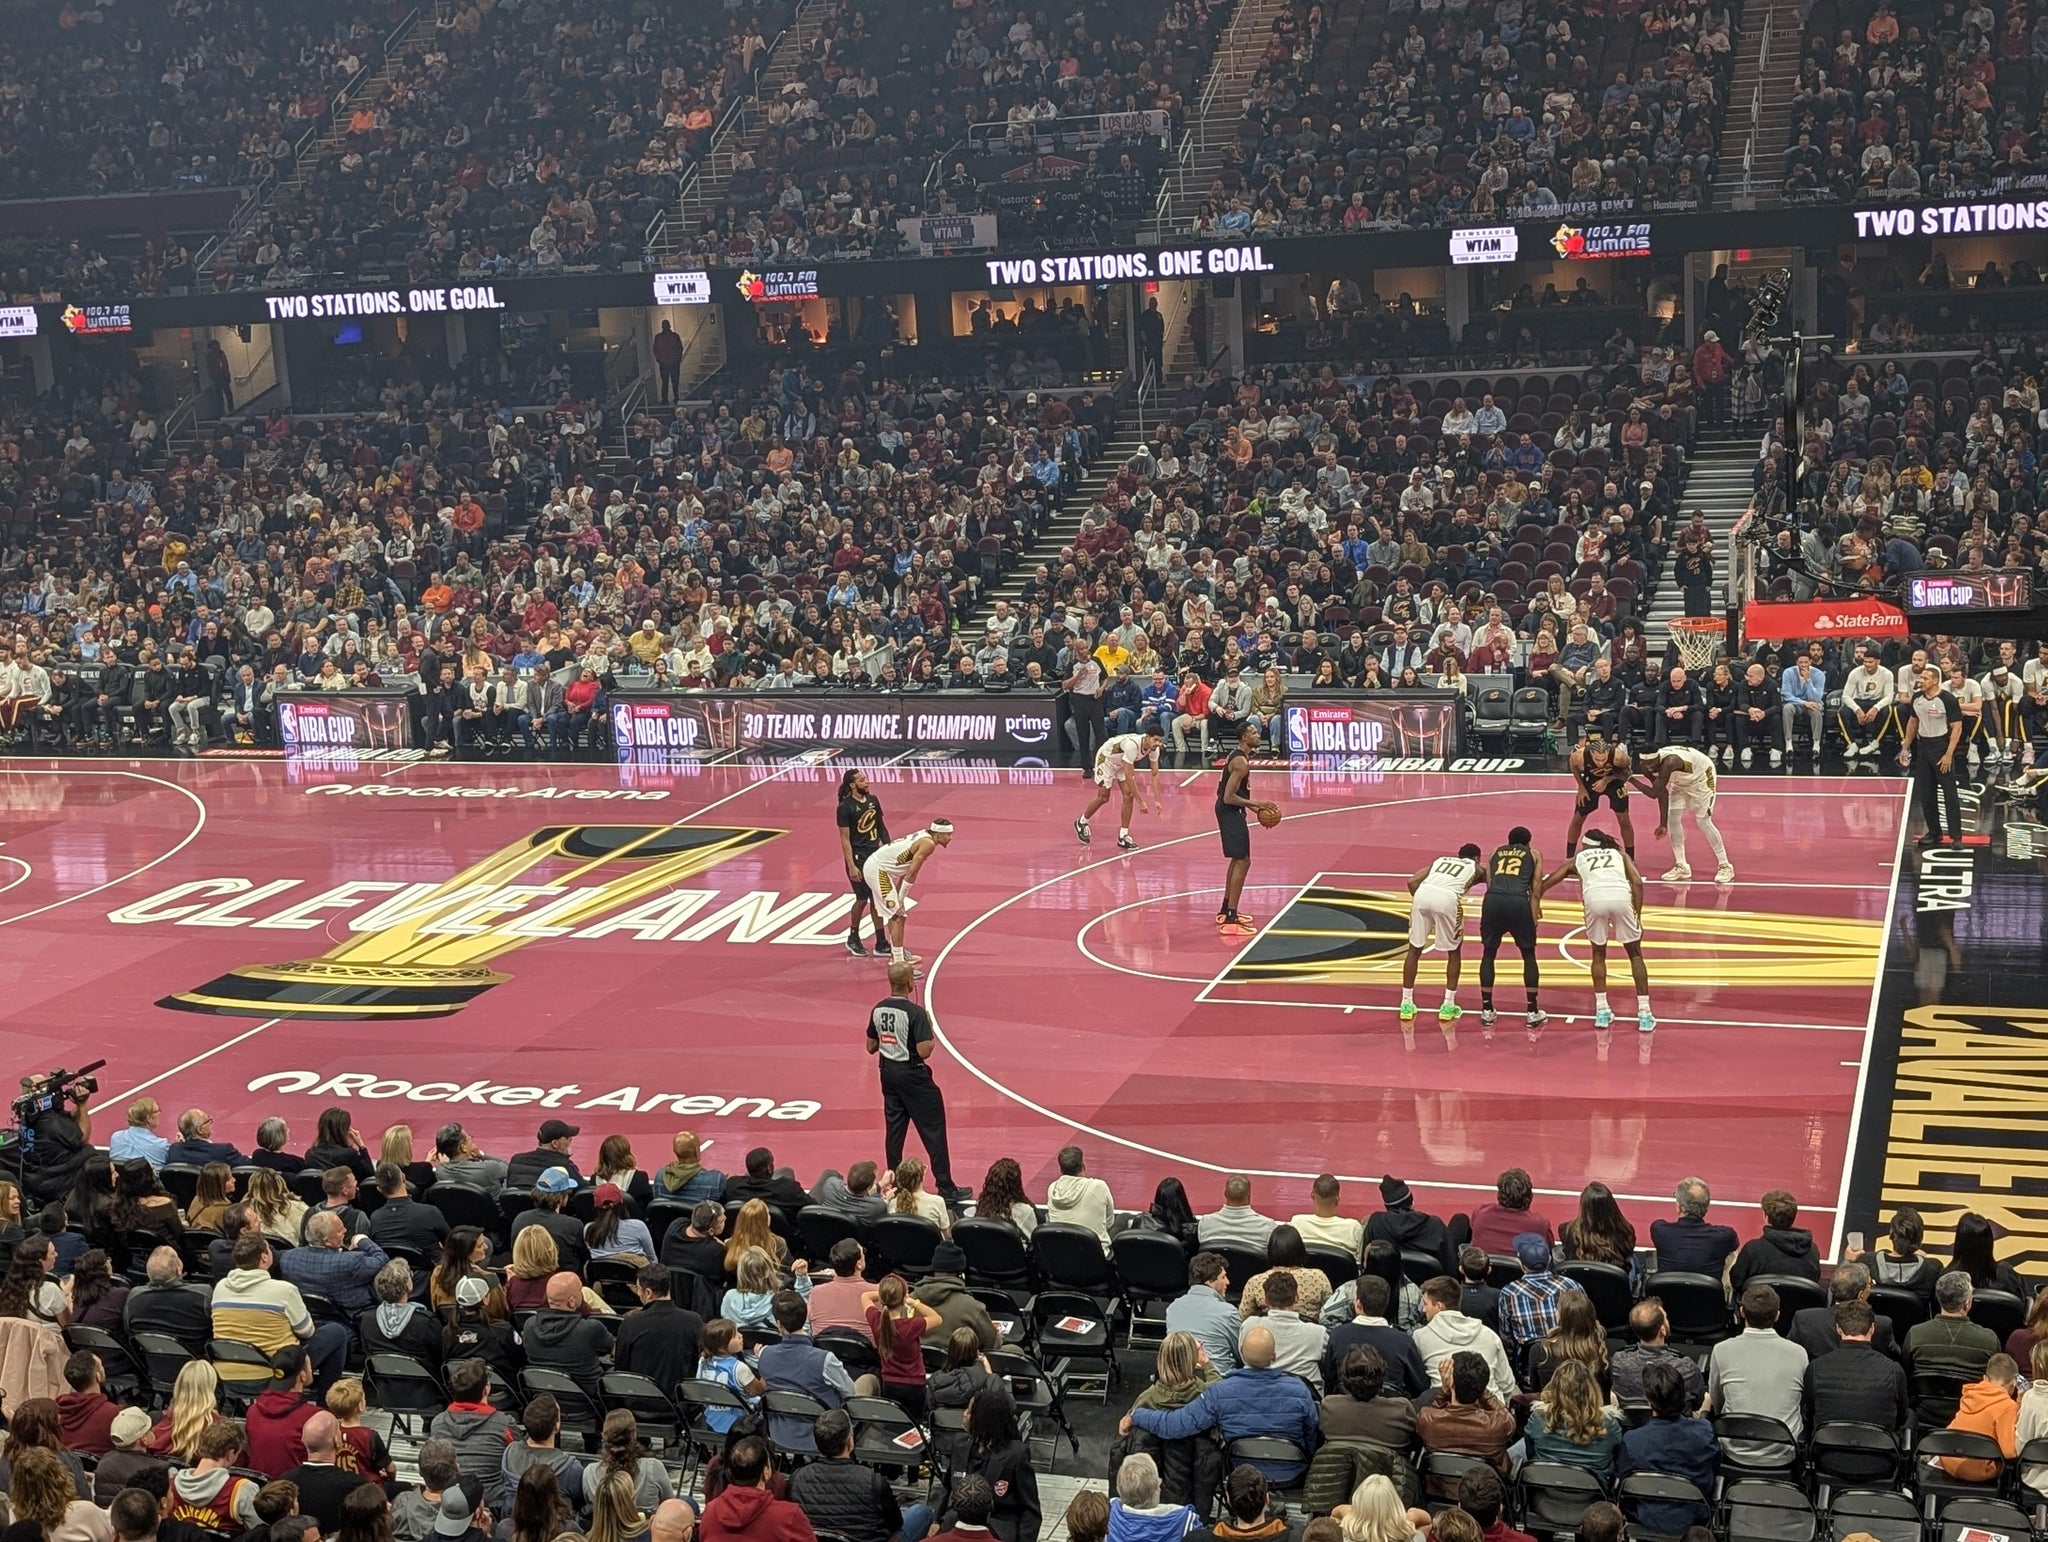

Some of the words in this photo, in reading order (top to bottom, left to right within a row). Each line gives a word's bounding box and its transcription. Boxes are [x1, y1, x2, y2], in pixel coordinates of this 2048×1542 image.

[1103, 117, 1121, 130] LOS
[1653, 200, 1697, 211] Huntington
[1854, 208, 1915, 237] TWO
[1921, 201, 2048, 235] STATIONS
[933, 227, 962, 239] WTAM
[1455, 229, 1512, 237] NEWSRADIO
[1587, 225, 1622, 238] 100.7
[1627, 224, 1650, 236] FM
[1466, 239, 1501, 252] WTAM
[986, 259, 1037, 285] TWO
[1041, 254, 1153, 283] STATIONS.
[1158, 250, 1203, 276] ONE
[1208, 246, 1274, 273] GOAL.
[766, 271, 794, 283] 100.7
[798, 270, 817, 281] FM
[667, 283, 696, 295] WTAM
[87, 306, 110, 316] 100.7
[113, 305, 129, 315] FM
[265, 297, 308, 319] TWO
[311, 291, 406, 316] STATIONS.
[408, 288, 447, 312] ONE
[450, 286, 505, 309] GOAL.
[1927, 588, 1949, 606] NBA
[1951, 586, 1972, 605] CUP
[299, 706, 327, 714] Emirates
[635, 707, 668, 716] Emirates
[1313, 710, 1349, 719] Emirates
[300, 717, 327, 743] NBA
[329, 716, 355, 742] CUP
[635, 718, 667, 745] NBA
[669, 717, 698, 745] CUP
[743, 714, 763, 739] 30
[766, 714, 817, 740] TEAMS.
[821, 714, 832, 739] 8
[833, 714, 902, 740] ADVANCE.
[907, 714, 914, 740] 1
[916, 714, 997, 741] CHAMPION
[1005, 716, 1051, 733] prime
[1311, 721, 1347, 751] NBA
[1349, 721, 1383, 751] CUP
[1370, 757, 1443, 771] NBA
[1450, 758, 1526, 772] CUP
[347, 784, 518, 798] Rocket
[521, 786, 671, 800] Arena
[1435, 862, 1465, 877] 00
[1495, 858, 1521, 876] 12
[1587, 855, 1615, 871] 22
[1916, 849, 1974, 912] ULTRA
[108, 877, 918, 945] CLEVELAND
[881, 1012, 895, 1033] 33
[320, 1071, 580, 1108] Rocket
[575, 1085, 823, 1121] Arena
[1875, 1004, 2048, 1277] CAVALIERS
